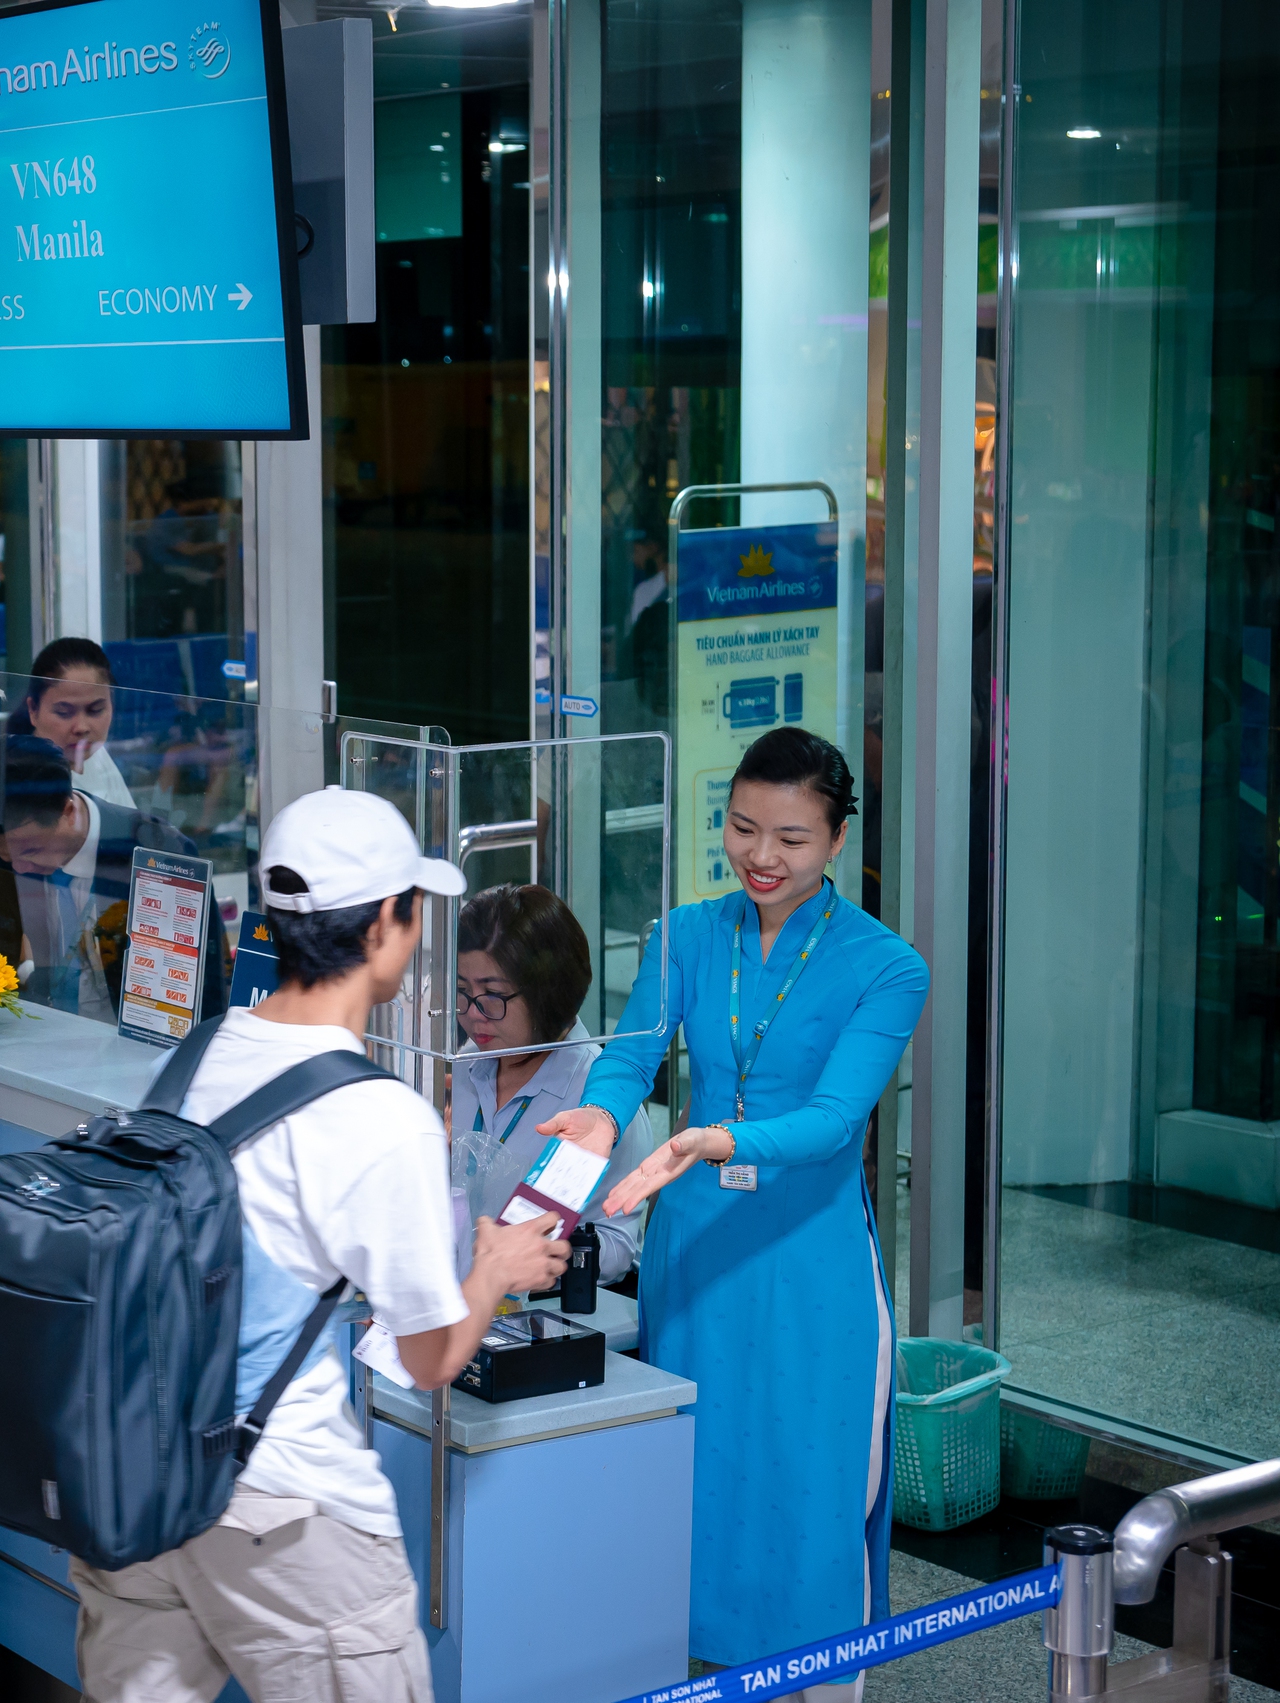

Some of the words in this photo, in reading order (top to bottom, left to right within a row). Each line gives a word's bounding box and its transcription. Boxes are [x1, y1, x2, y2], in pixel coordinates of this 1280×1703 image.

[61, 39, 178, 85] Airlines
[10, 154, 97, 200] VN648
[15, 219, 105, 262] Manila
[97, 284, 219, 317] ECONOMY
[707, 585, 759, 603] Vietnam
[759, 579, 806, 598] Airlines
[805, 625, 820, 640] TAY
[705, 650, 729, 667] HAND
[729, 648, 764, 665] BAGGAGE
[766, 642, 810, 660] ALLOWANCE
[564, 701, 581, 710] AUTO
[740, 1663, 783, 1694] TAN
[787, 1649, 831, 1681] SON
[835, 1630, 890, 1665] NHAT
[894, 1580, 1046, 1645] INTERNATIONAL
[651, 1692, 670, 1703] TAN
[671, 1685, 691, 1699] SON
[692, 1676, 717, 1693] NHAT
